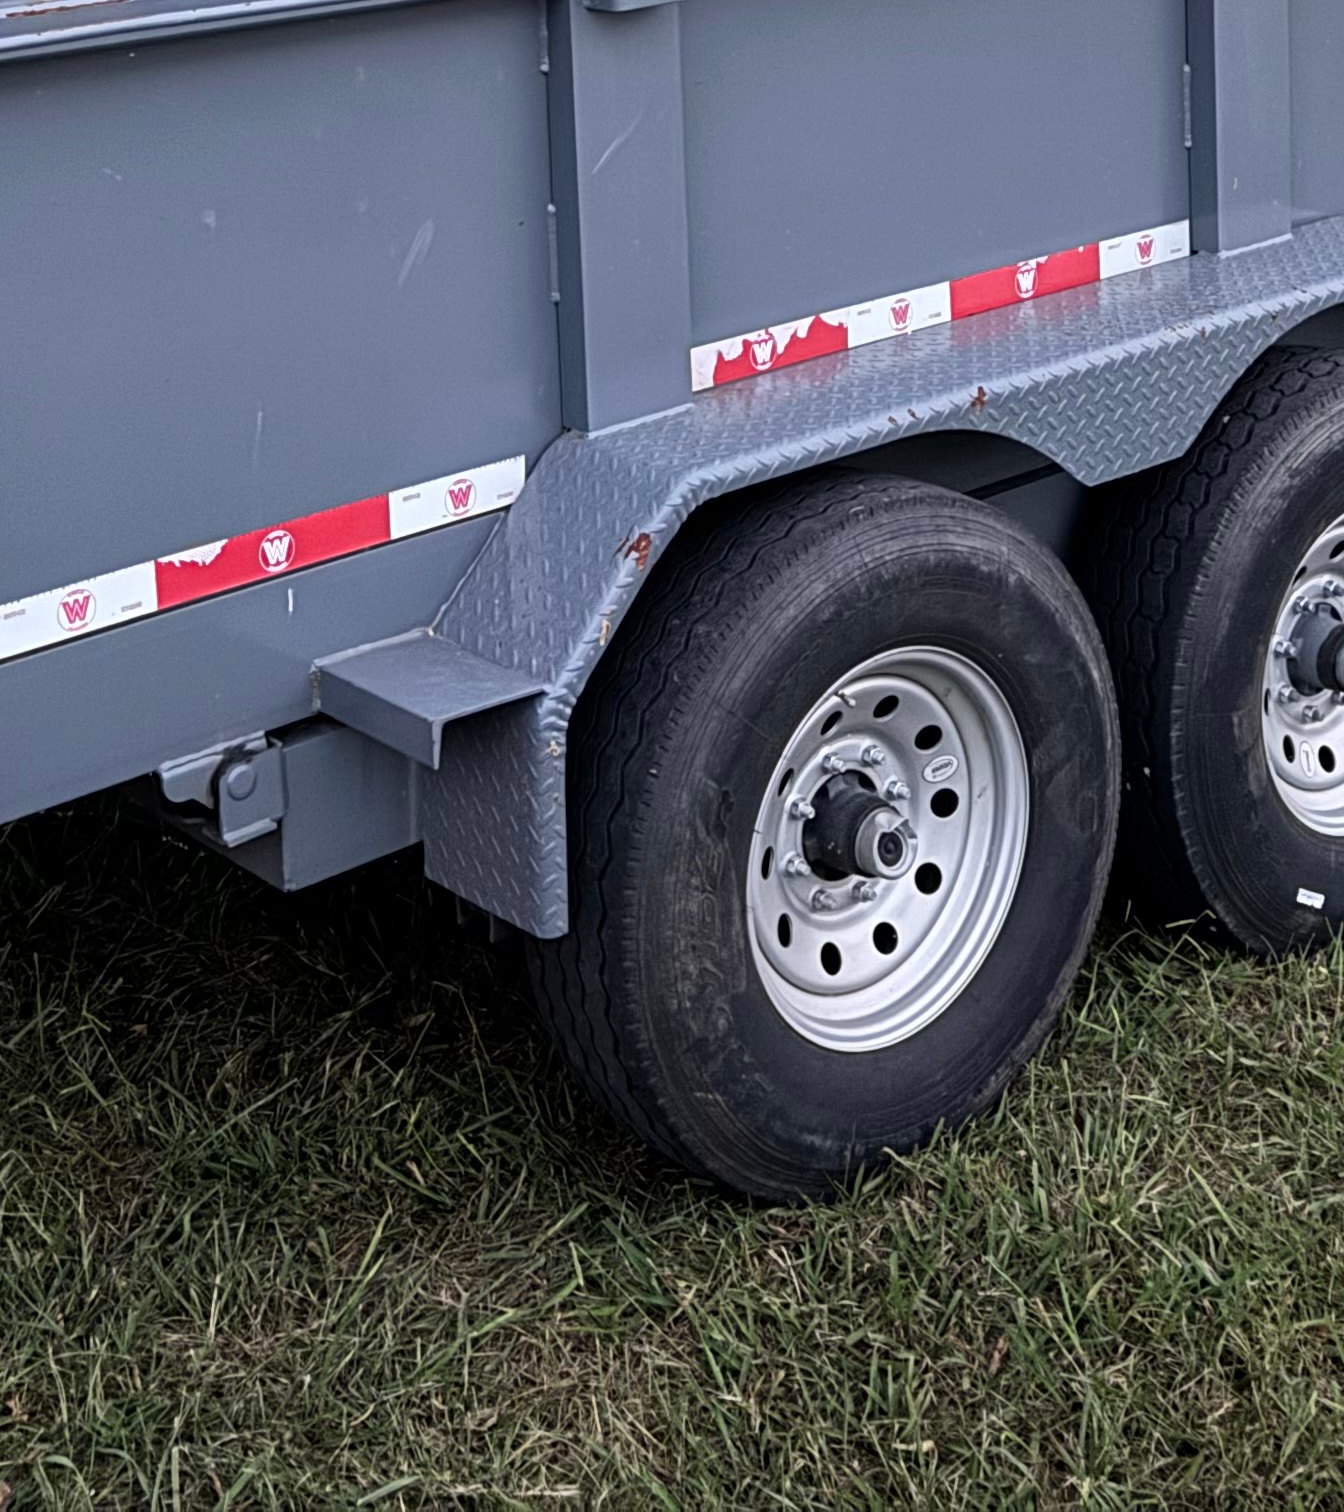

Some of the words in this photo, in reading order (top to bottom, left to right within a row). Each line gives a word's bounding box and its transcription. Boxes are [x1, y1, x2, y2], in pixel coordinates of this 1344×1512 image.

[1137, 238, 1154, 259] W
[1017, 269, 1036, 293] W
[891, 303, 911, 325] W
[753, 340, 774, 364] W
[448, 484, 473, 510] W
[262, 535, 291, 565] W
[62, 594, 91, 625] W
